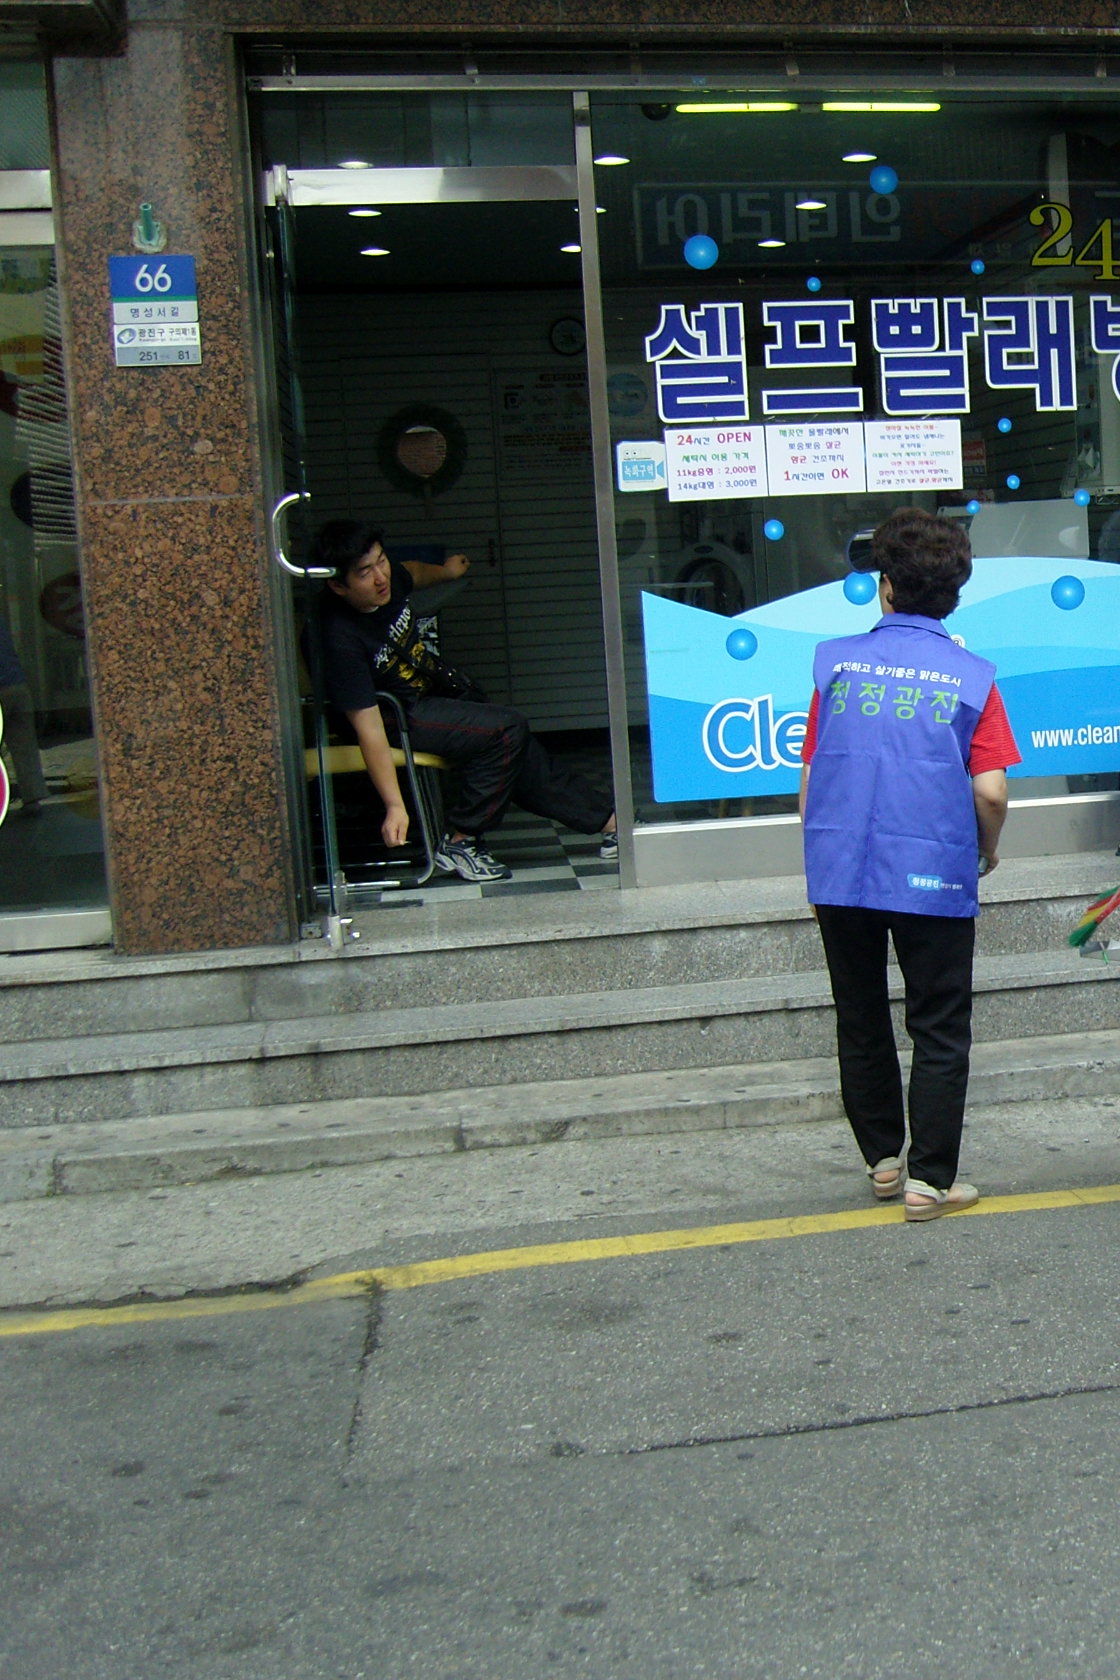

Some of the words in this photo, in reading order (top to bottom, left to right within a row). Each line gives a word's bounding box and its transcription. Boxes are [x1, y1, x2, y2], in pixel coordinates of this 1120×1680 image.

[135, 264, 172, 292] 66
[138, 327, 165, 338] 광진구
[139, 351, 158, 361] 251
[178, 350, 190, 360] 81
[677, 434, 710, 446] 24시간
[717, 432, 752, 445] OPEN
[712, 452, 728, 461] 이용
[724, 465, 757, 475] 2,000원
[784, 470, 825, 481] 1시간이면
[831, 468, 849, 479] OK
[725, 479, 757, 488] 3,000원
[919, 669, 962, 688] 맑은도시
[830, 680, 959, 724] 청정광진
